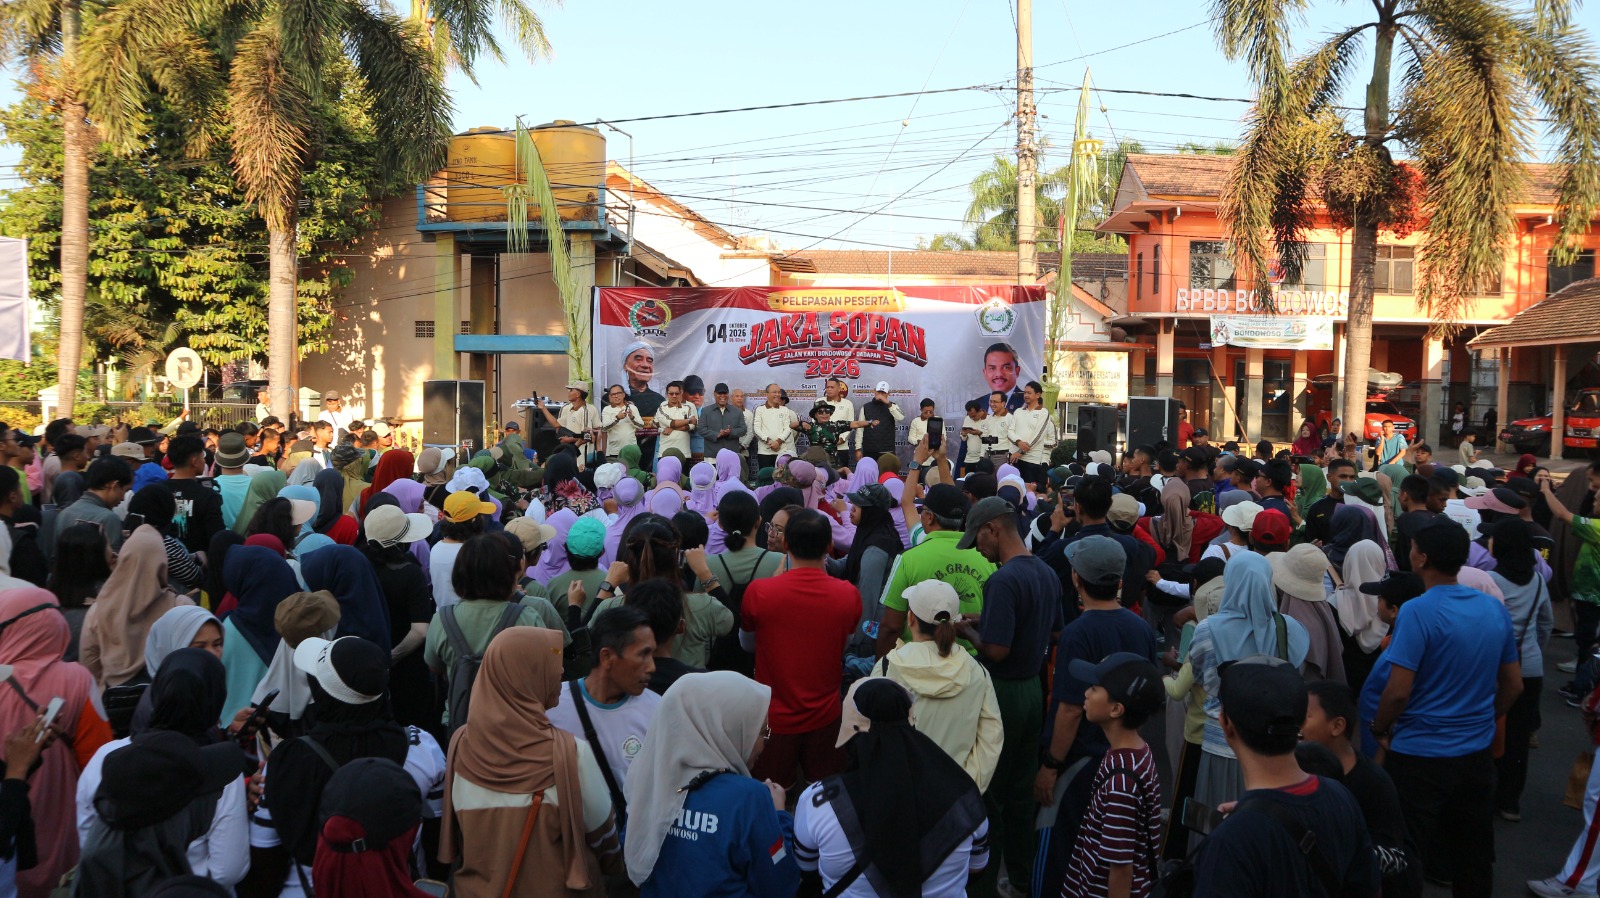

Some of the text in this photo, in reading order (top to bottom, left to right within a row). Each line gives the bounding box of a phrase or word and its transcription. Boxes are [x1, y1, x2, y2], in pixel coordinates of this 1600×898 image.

[782, 295, 890, 307] PELEPASAN PESERTA
[1176, 287, 1350, 315] BPBD BODOWOS
[706, 323, 728, 344] 04
[728, 328, 747, 338] 2026
[738, 310, 928, 368] JAKA SOPAN
[1234, 329, 1282, 338] BONDOWOSO
[783, 351, 803, 359] JALAN
[856, 351, 882, 359] DADAPAN
[804, 358, 861, 379] 2026
